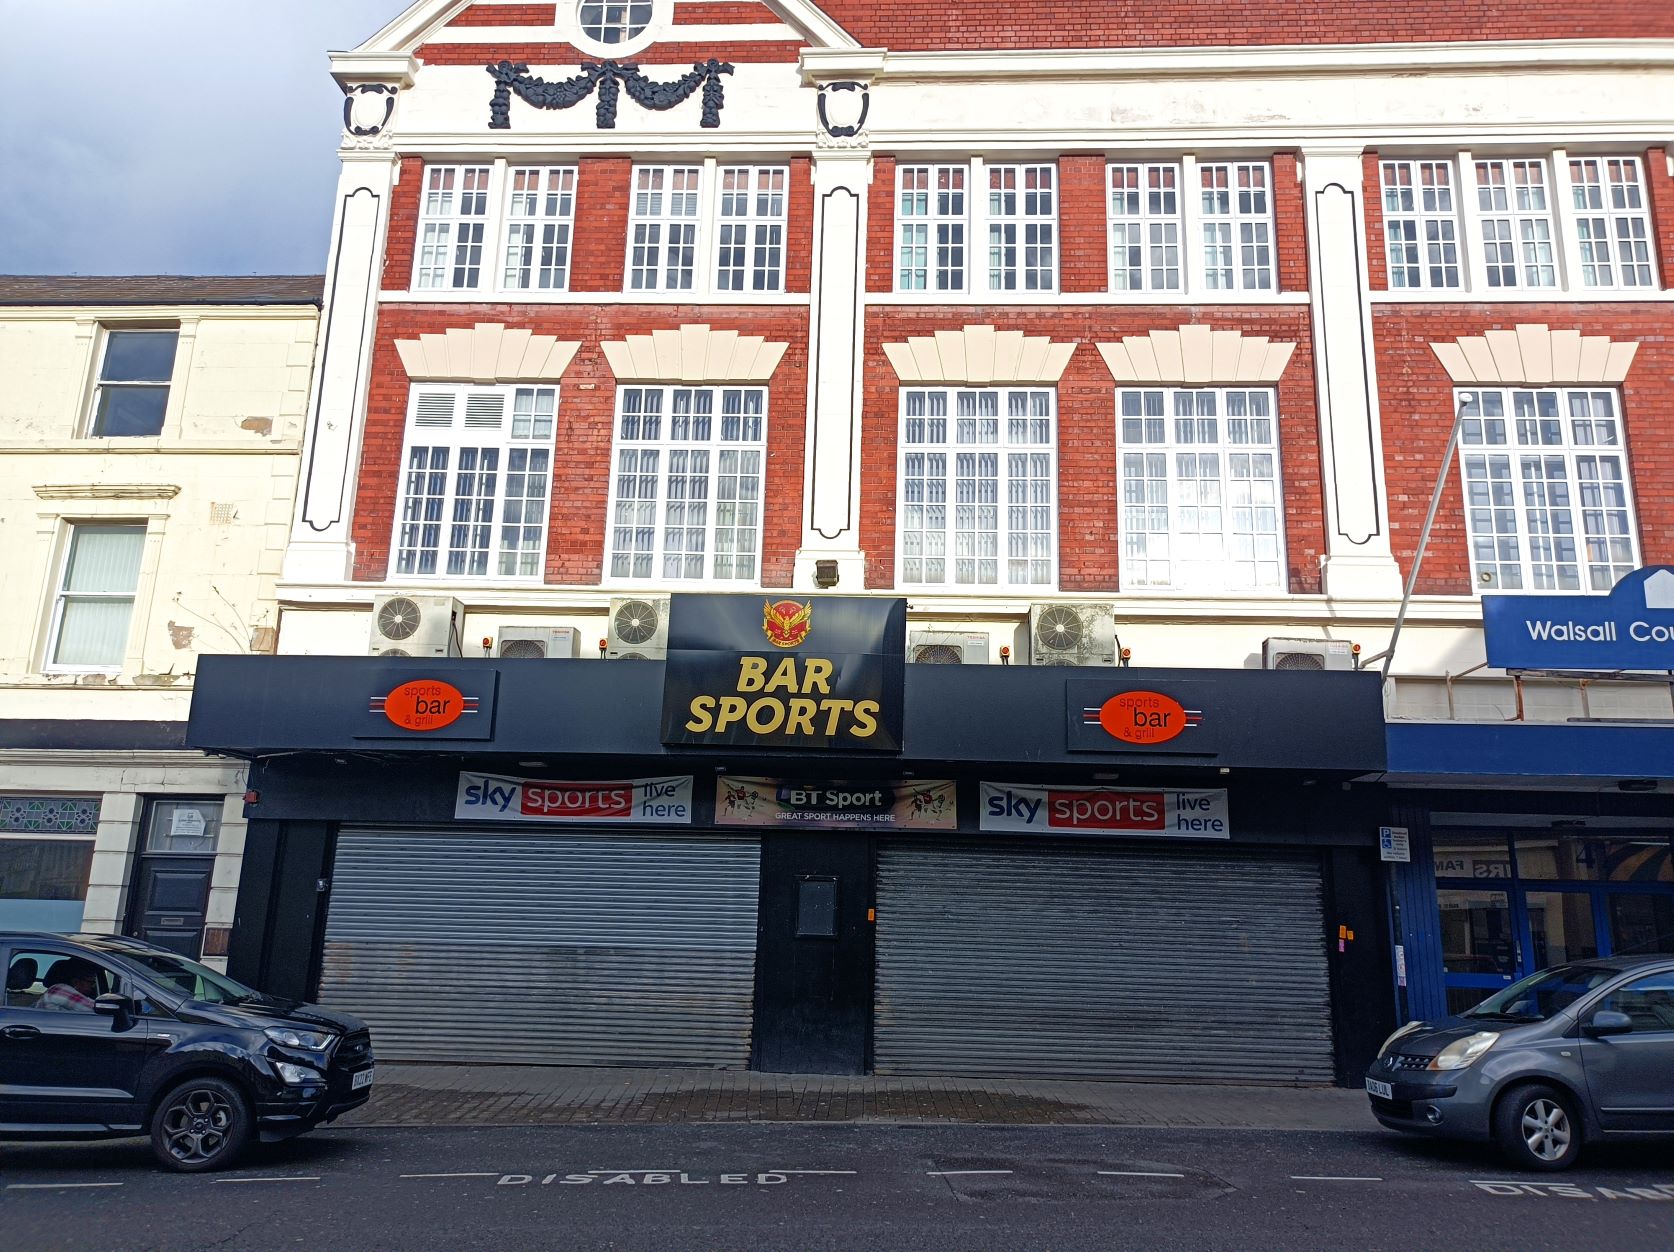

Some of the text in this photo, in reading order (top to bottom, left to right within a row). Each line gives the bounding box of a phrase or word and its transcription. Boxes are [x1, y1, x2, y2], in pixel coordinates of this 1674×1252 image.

[1525, 620, 1617, 642] Walsall
[736, 656, 833, 694] BAR
[404, 685, 441, 698] sports
[415, 696, 450, 714] bar
[1119, 697, 1159, 710] sports
[404, 714, 433, 726] & grill
[685, 695, 880, 737] SPORTS
[1133, 707, 1171, 727] bar
[1123, 727, 1154, 740] & grill
[465, 779, 626, 813] sky sports
[643, 782, 676, 797] live
[790, 789, 882, 808] BT Sport
[643, 801, 685, 817] here
[988, 790, 1158, 825] sky sports
[1176, 793, 1211, 811] live
[775, 812, 896, 822] GREAT SPORT HAPPENS HERE
[1177, 813, 1223, 832] here
[497, 1173, 788, 1185] DISABLED
